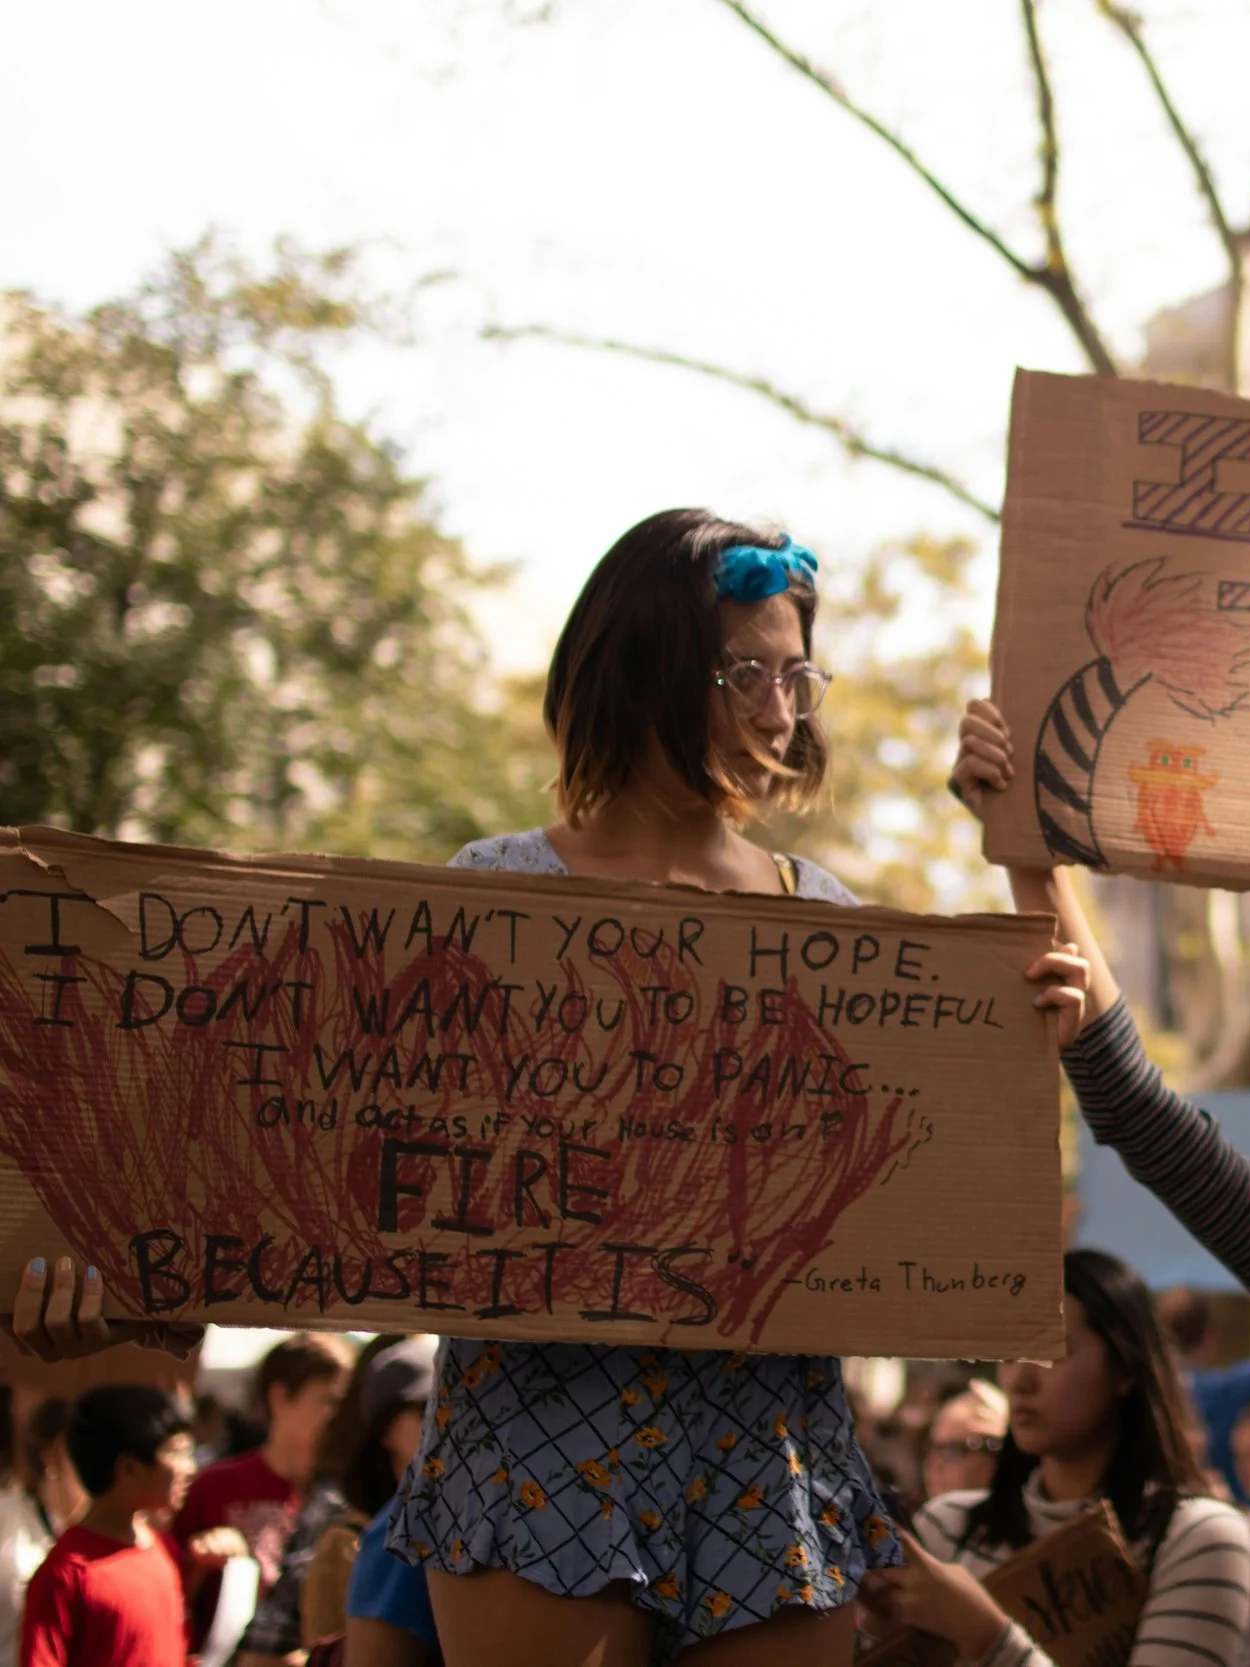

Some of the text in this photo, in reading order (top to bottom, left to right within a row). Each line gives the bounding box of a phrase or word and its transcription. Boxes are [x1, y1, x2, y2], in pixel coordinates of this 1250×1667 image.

[138, 892, 327, 962] DON'T
[552, 915, 705, 966] YOUR
[749, 925, 940, 984] HOPE.
[31, 972, 88, 1028] I
[115, 969, 316, 1030] DON'T
[535, 979, 624, 1034] YOU
[639, 985, 694, 1027] TO
[722, 985, 787, 1028] BE
[818, 984, 1005, 1030] HOPEFUL
[222, 1040, 290, 1087] I
[313, 1043, 479, 1094] WANT
[504, 1052, 610, 1101] YOU
[628, 1050, 685, 1093] TO
[255, 1098, 338, 1132] and
[355, 1103, 416, 1136] act
[429, 1115, 468, 1138] as
[751, 1120, 807, 1144] on
[377, 1137, 612, 1235] FIRE
[129, 1228, 466, 1316] BECAUSE
[472, 1241, 575, 1319] IT
[897, 1261, 1027, 1297] Thunberg
